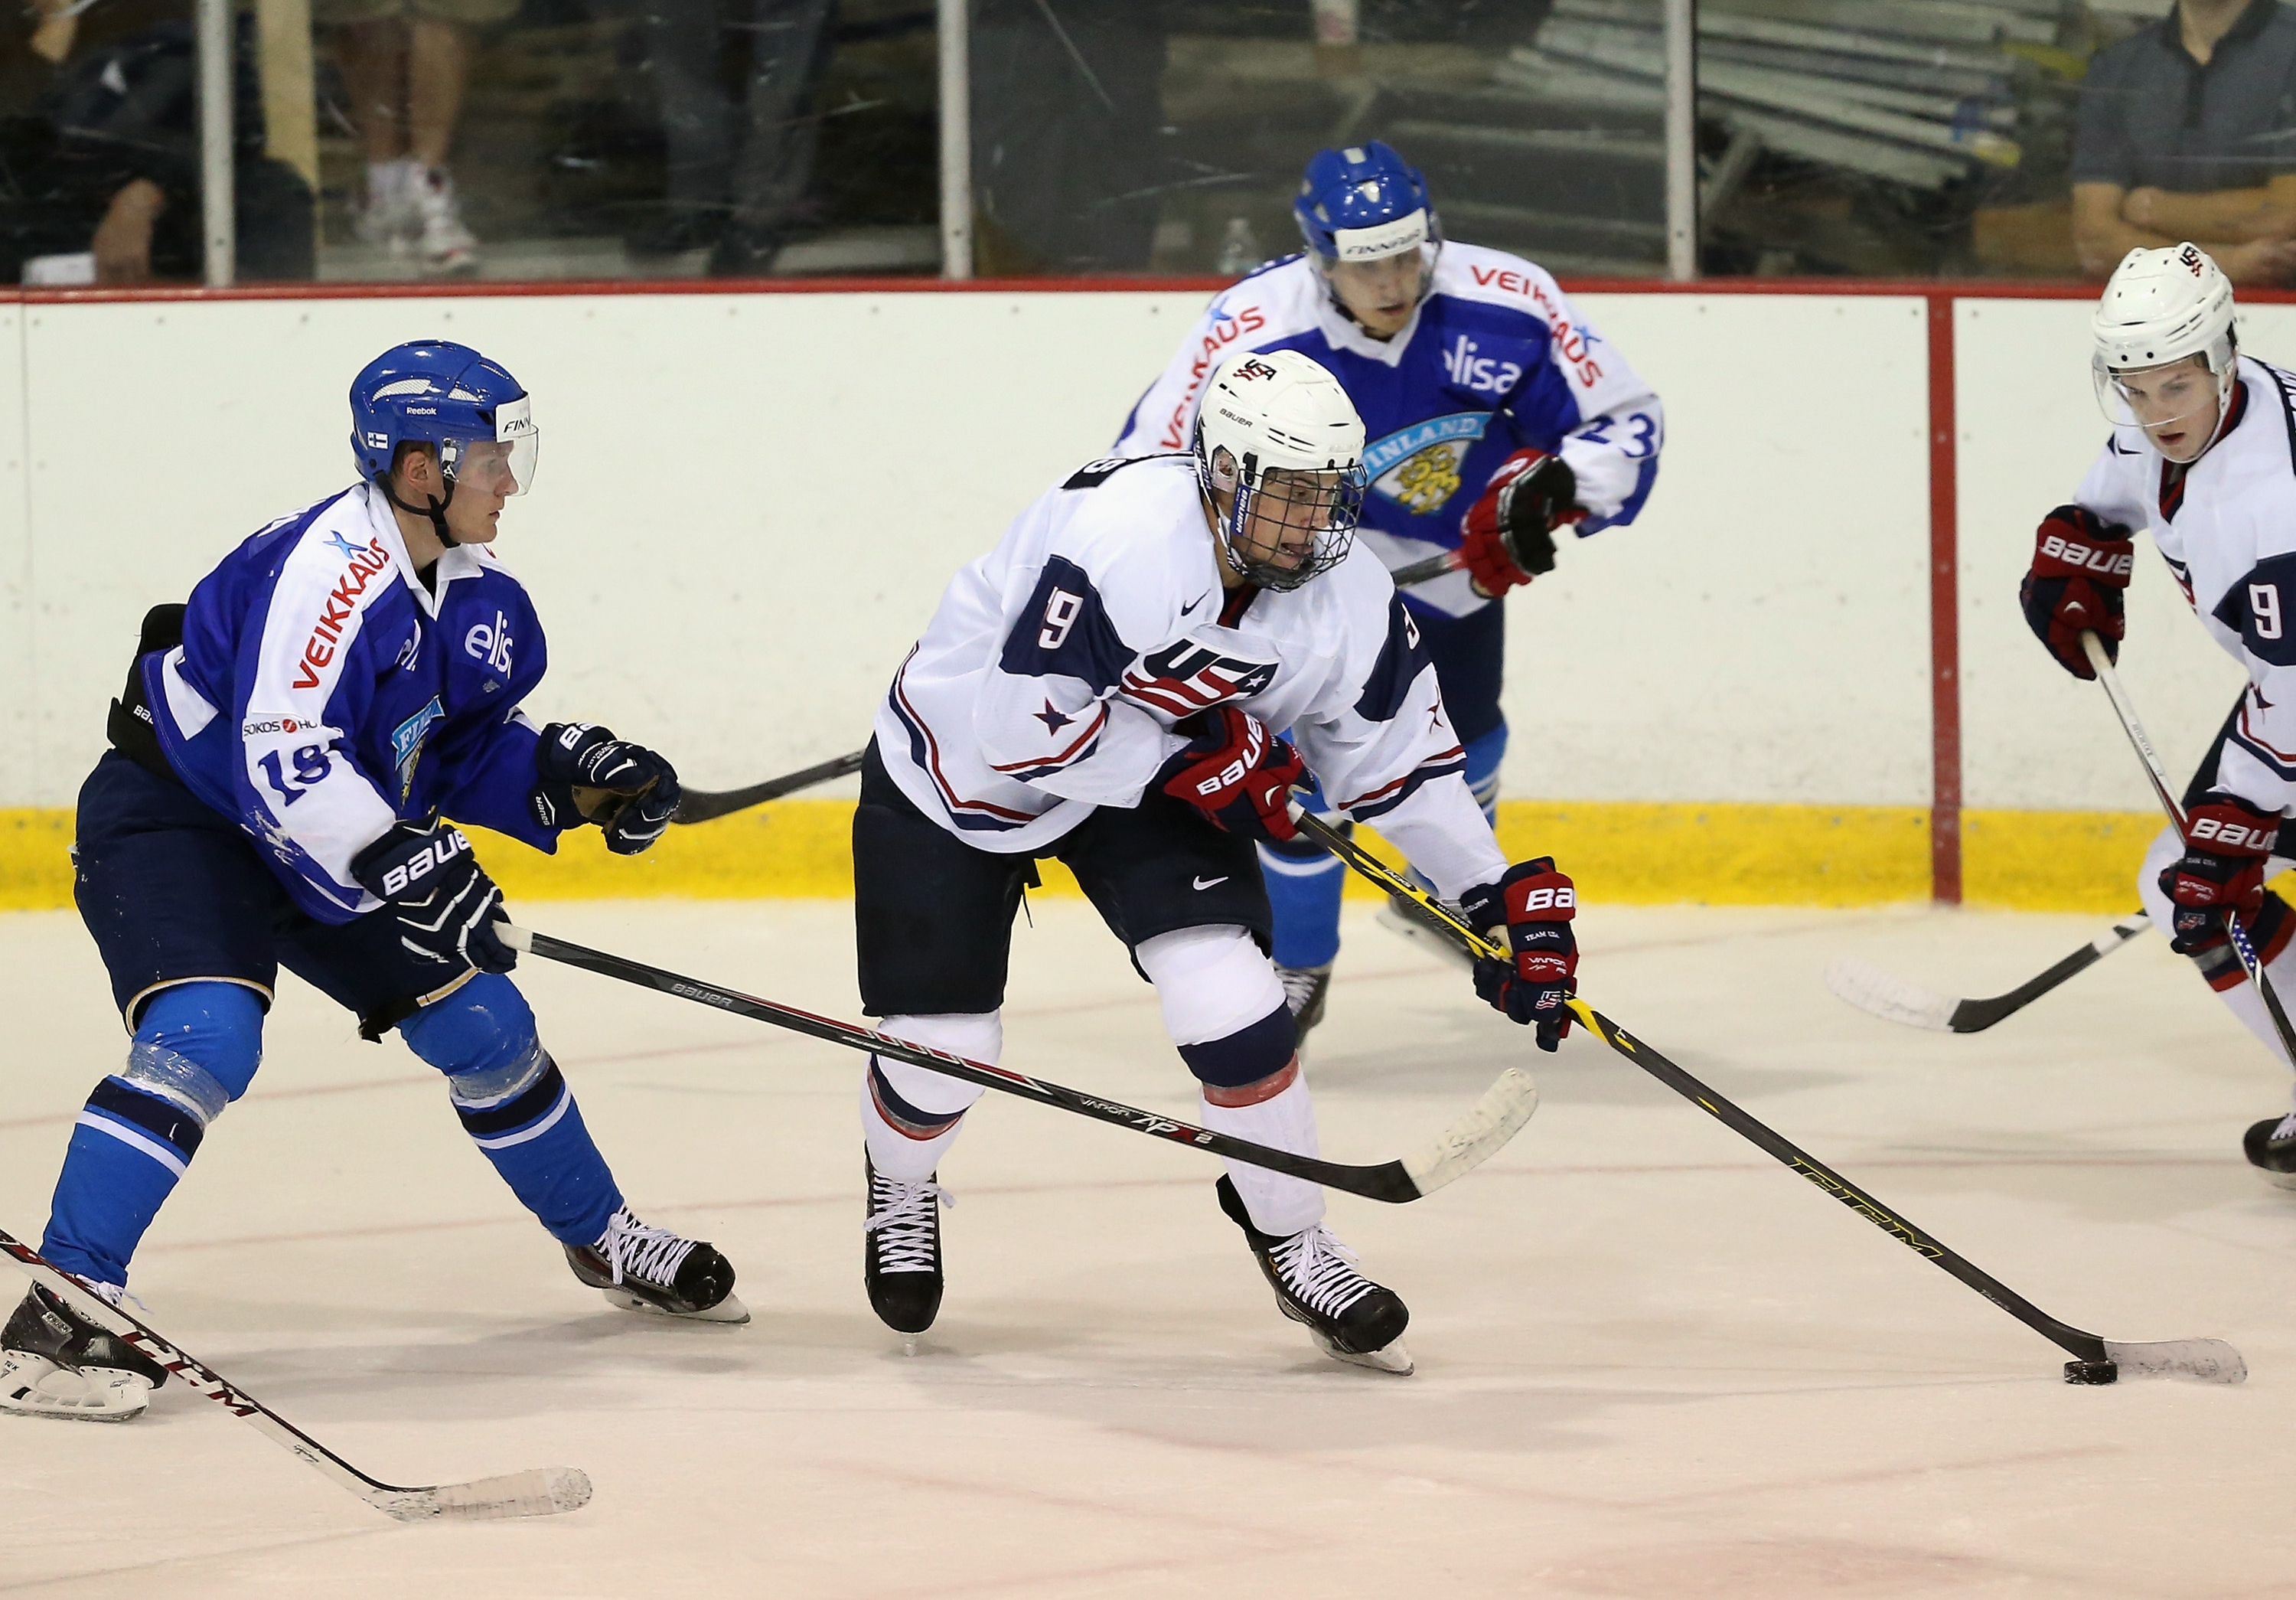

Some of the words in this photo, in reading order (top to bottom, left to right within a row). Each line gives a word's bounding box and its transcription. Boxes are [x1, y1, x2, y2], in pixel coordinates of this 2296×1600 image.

[1232, 358, 1278, 382] USA
[1443, 334, 1522, 394] lisa
[406, 406, 438, 416] Reebok
[1578, 412, 1656, 459] 23
[1361, 417, 1479, 469] INLAND
[292, 536, 391, 690] VEIKKAUS
[1037, 587, 1084, 650] 9
[2248, 583, 2283, 640] 9
[465, 609, 514, 680] elis
[1120, 636, 1281, 717] USA
[243, 721, 281, 736] SOKOS
[257, 744, 332, 808] 18
[1078, 1097, 1131, 1119] VAPOR
